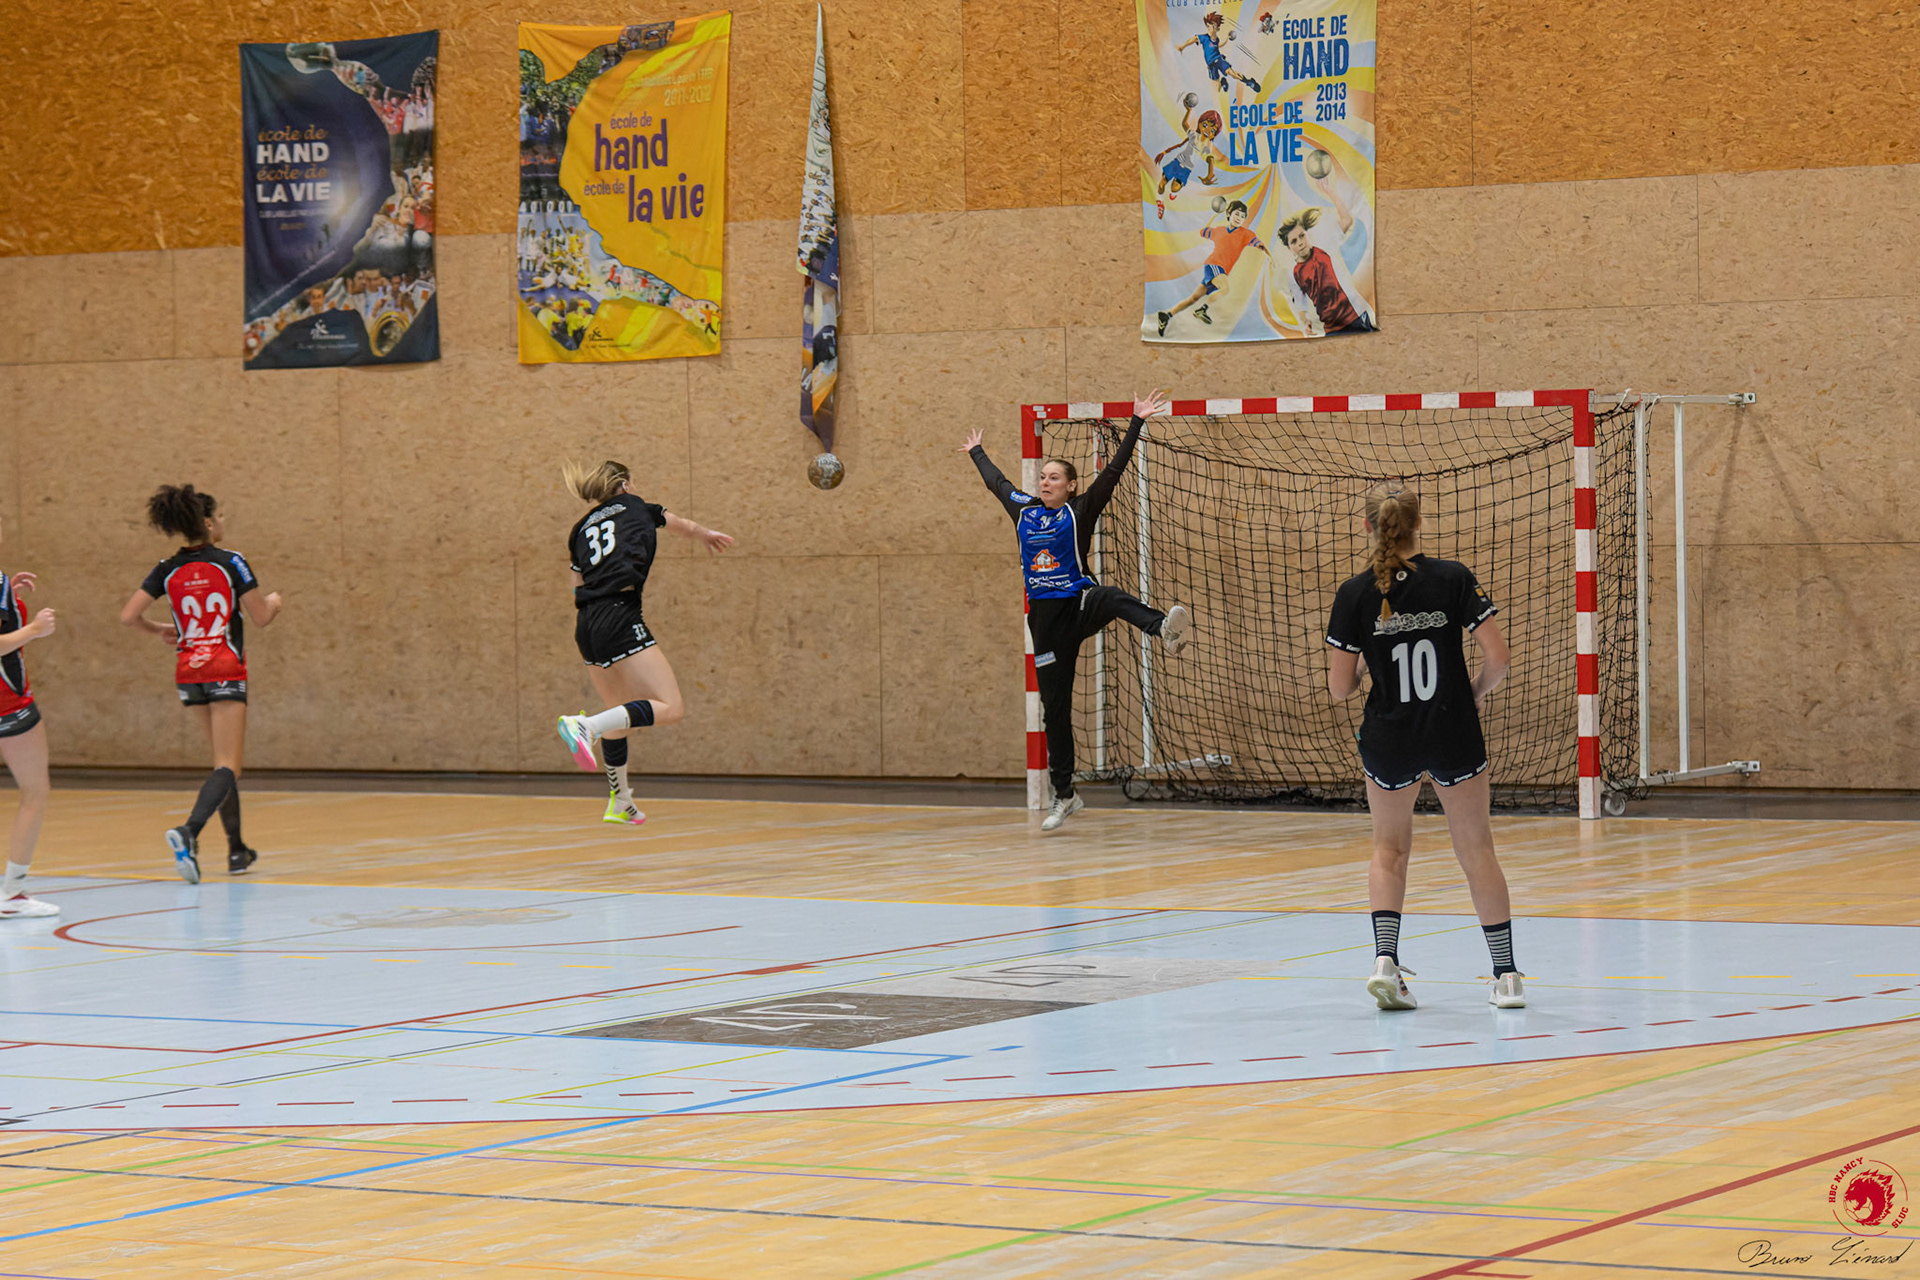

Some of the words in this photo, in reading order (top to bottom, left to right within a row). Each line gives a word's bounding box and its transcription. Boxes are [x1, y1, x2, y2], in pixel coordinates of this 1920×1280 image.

[1282, 13, 1325, 40] ÉCOLE
[1330, 14, 1348, 36] DE
[1283, 38, 1349, 80] HAND
[1317, 82, 1347, 102] 2013
[610, 112, 638, 130] école
[640, 111, 652, 127] de
[1229, 98, 1278, 128] ÉCOLE
[1284, 101, 1303, 125] DE
[1316, 102, 1346, 122] 2014
[304, 124, 328, 140] de
[594, 118, 669, 172] hand
[256, 142, 330, 164] HAND
[1229, 131, 1259, 166] LA
[1266, 128, 1303, 164] VIE
[257, 165, 301, 181] école
[304, 163, 328, 179] de
[256, 183, 289, 203] LA
[289, 182, 331, 201] VIE
[583, 179, 611, 196] école
[612, 178, 625, 195] de
[628, 174, 653, 223] la
[661, 172, 705, 221] vie
[585, 519, 616, 566] 33
[181, 592, 229, 638] 22
[1391, 638, 1438, 703] 10
